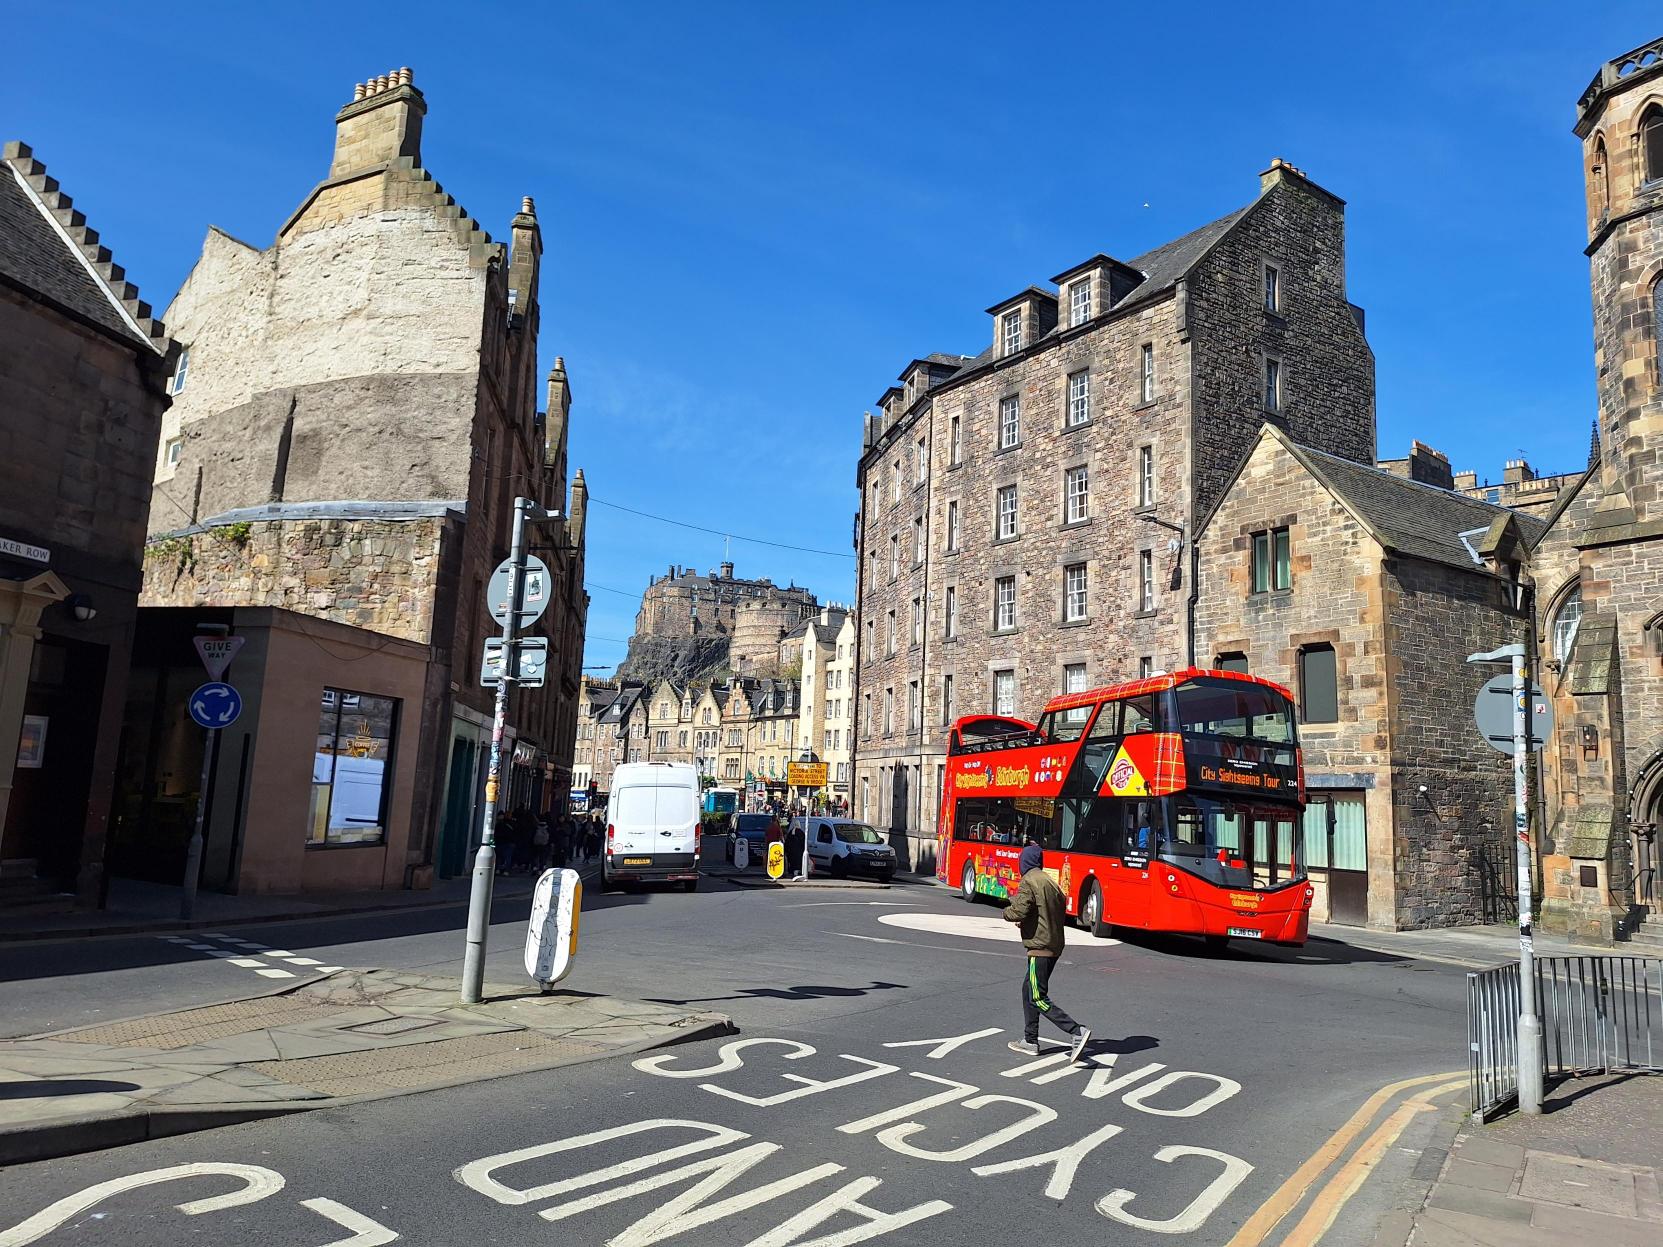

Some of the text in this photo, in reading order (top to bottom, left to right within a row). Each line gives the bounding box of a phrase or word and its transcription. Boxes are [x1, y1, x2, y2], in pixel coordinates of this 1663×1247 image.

[26, 547, 48, 559] ROW
[203, 642, 232, 651] GIVE
[996, 765, 1030, 789] Edinburgh
[1200, 766, 1281, 788] City Sightseeing Tour
[1287, 779, 1298, 787] 224
[883, 1027, 1242, 1117] ONLY
[631, 1038, 1255, 1234] CYCLES
[455, 1118, 953, 1247] AND
